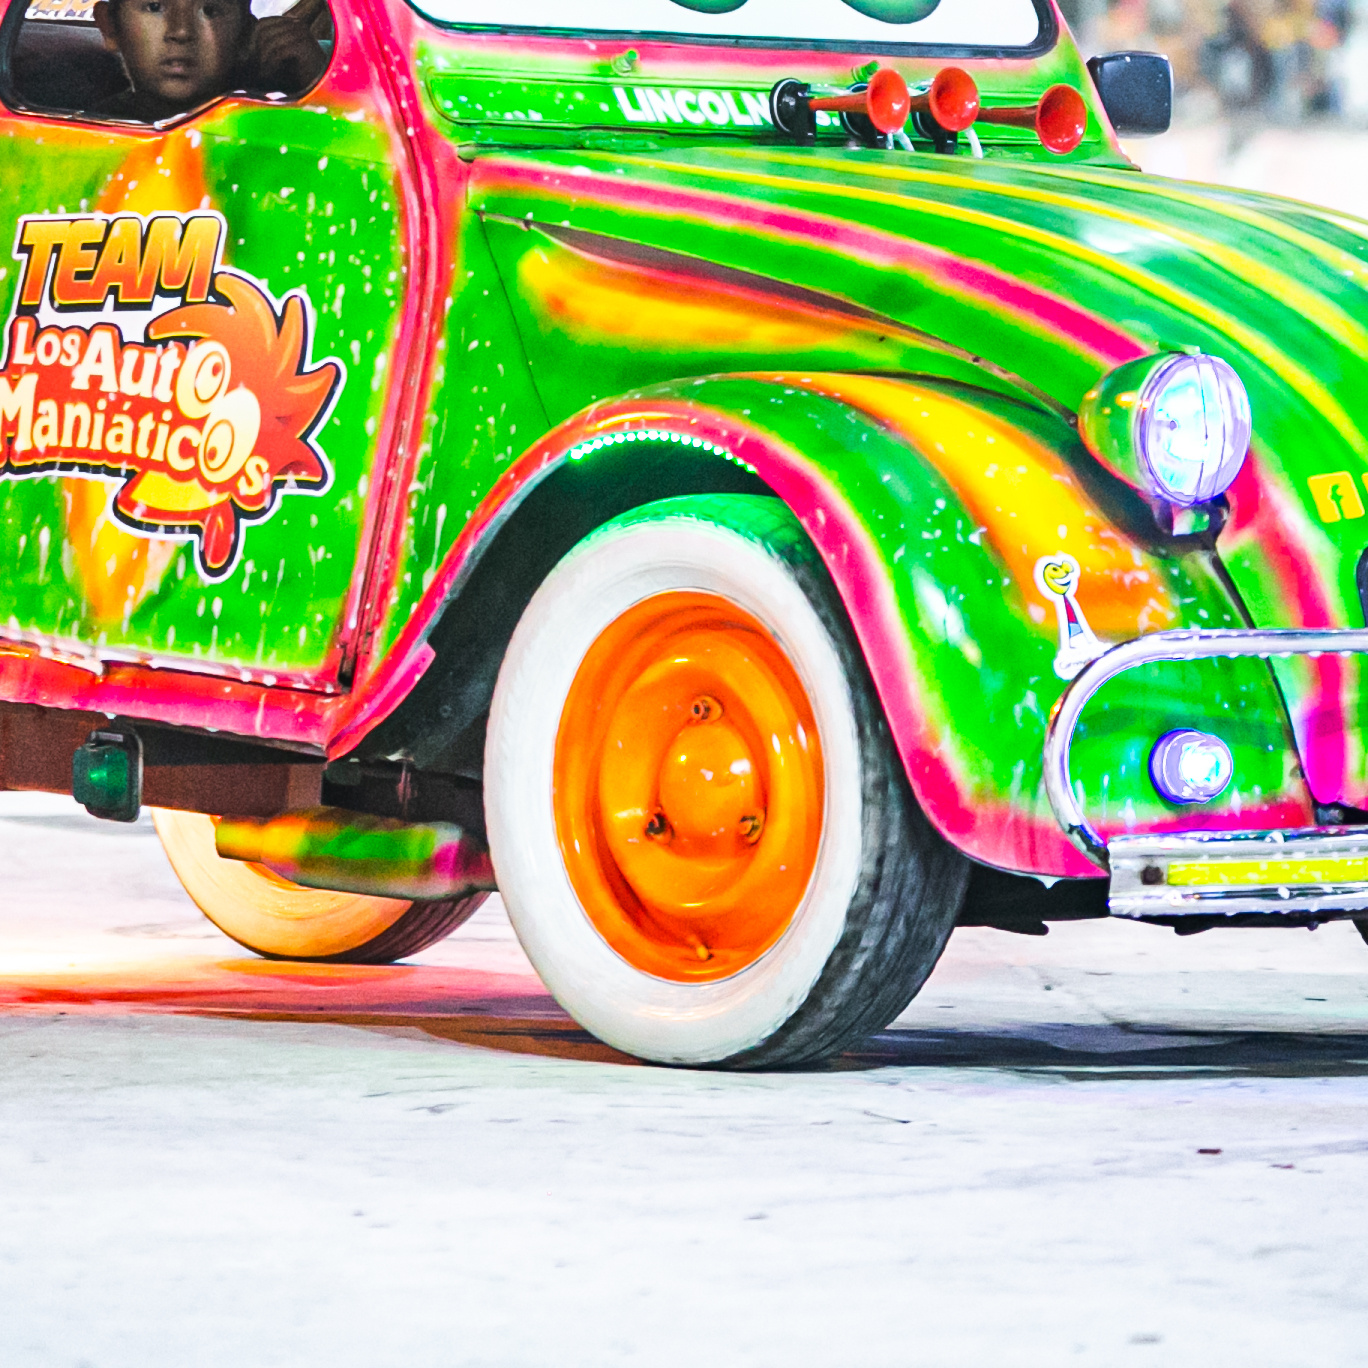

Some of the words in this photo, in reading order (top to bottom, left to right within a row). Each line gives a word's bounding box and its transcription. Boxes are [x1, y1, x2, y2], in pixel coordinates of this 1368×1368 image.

[613, 86, 774, 126] LINCOLN
[17, 215, 222, 313] TEAM
[12, 321, 81, 366] Los
[71, 329, 231, 420] Auto
